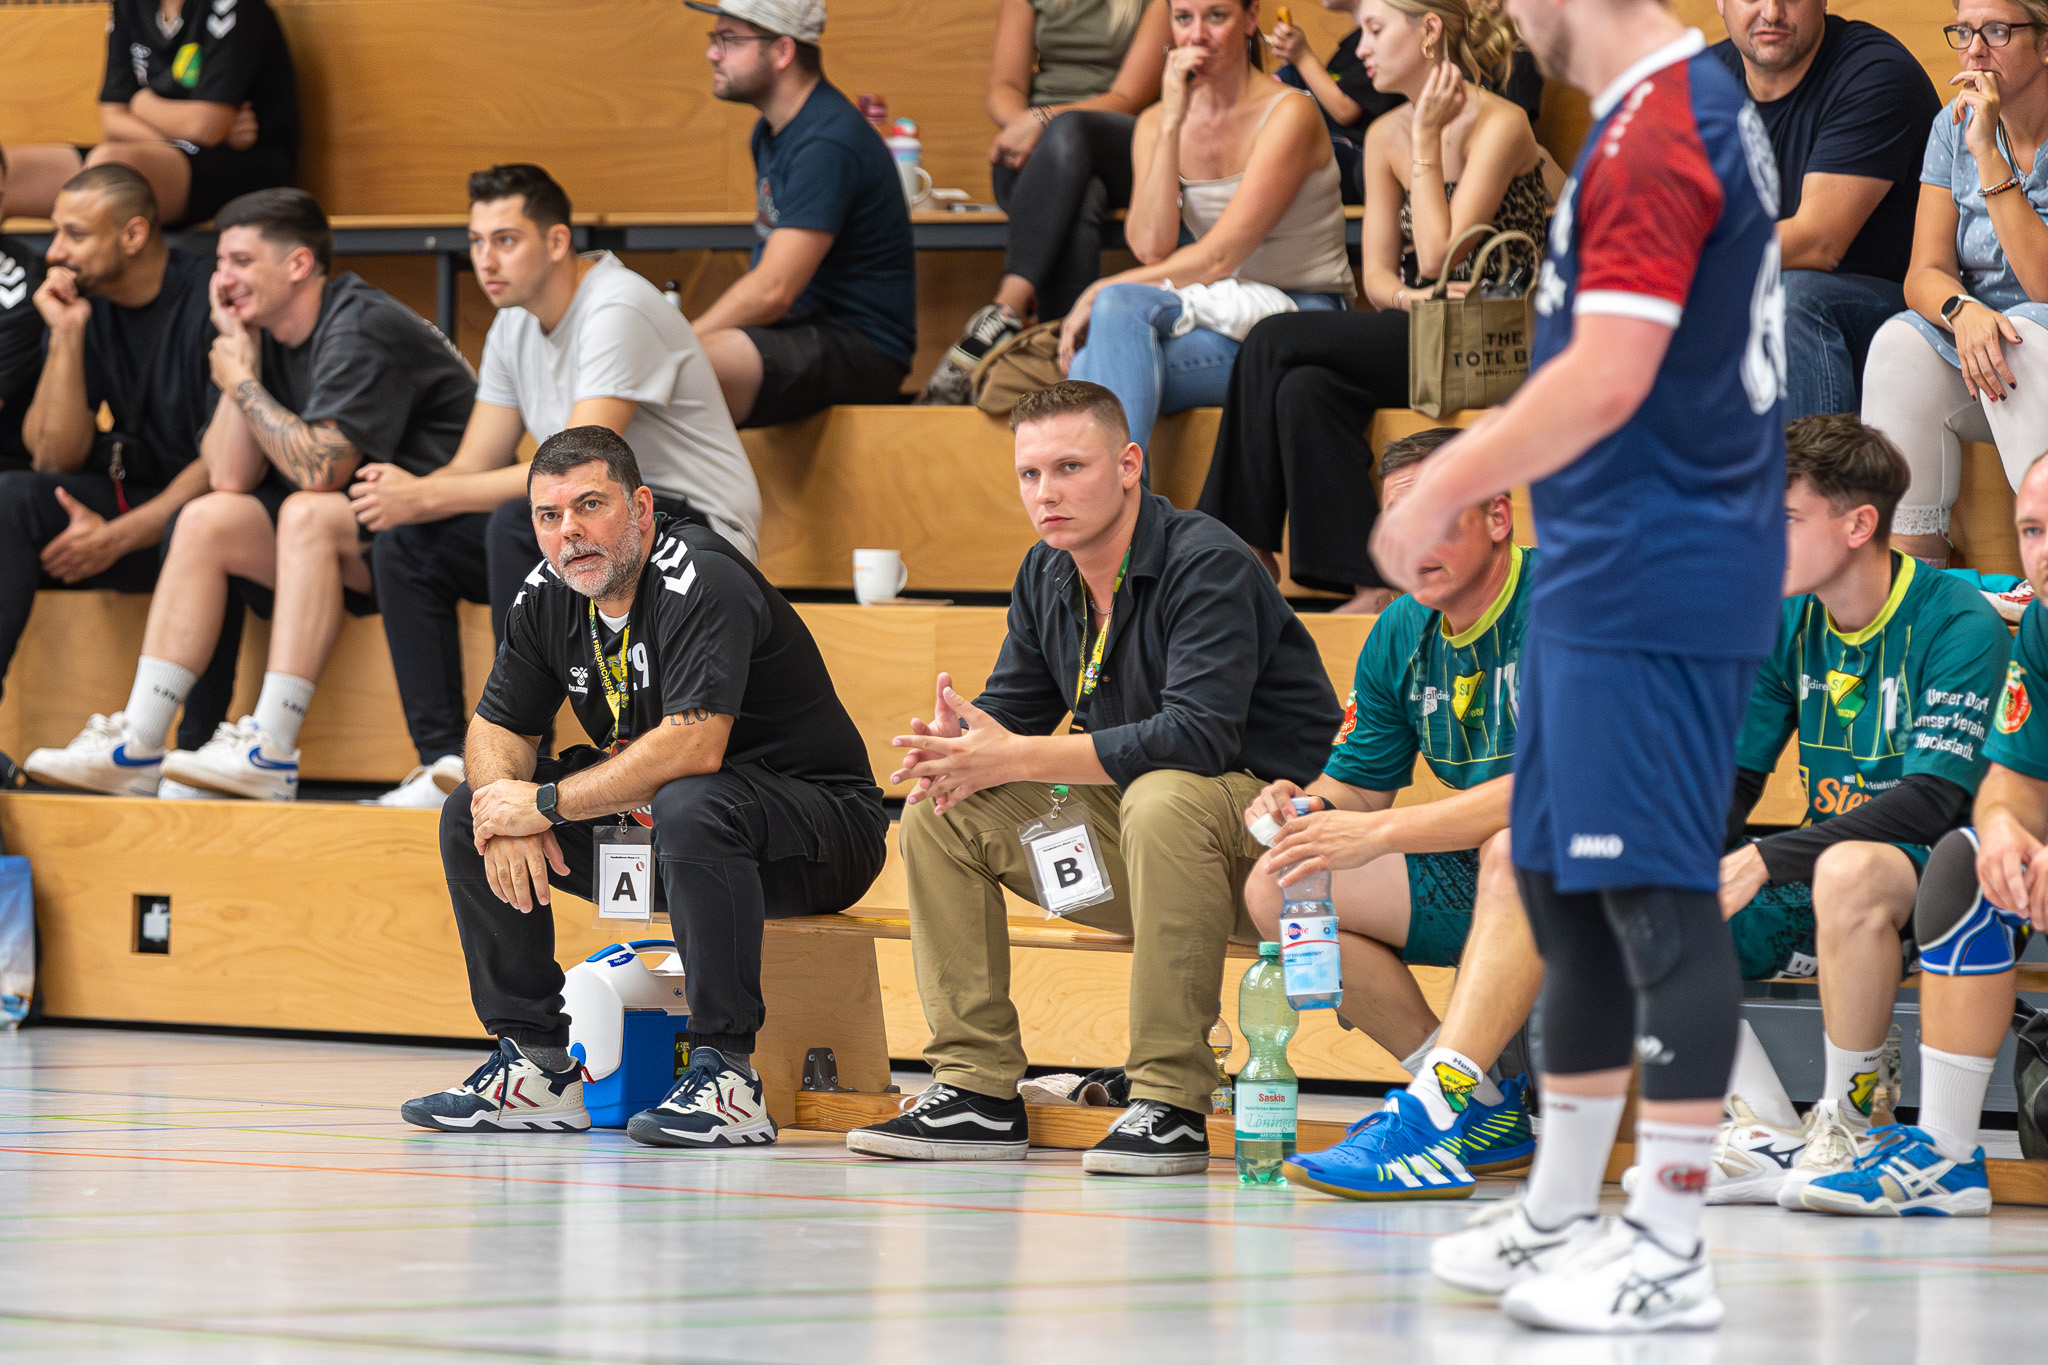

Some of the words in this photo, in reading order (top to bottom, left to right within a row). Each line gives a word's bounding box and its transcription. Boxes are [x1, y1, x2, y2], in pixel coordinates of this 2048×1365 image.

[1486, 331, 1523, 346] THE
[593, 639, 616, 698] FRIEDRICHSFE
[1926, 688, 1963, 707] Unser
[1568, 833, 1625, 859] JAKO
[1053, 857, 1083, 889] B
[612, 872, 637, 901] A
[1258, 1093, 1286, 1103] Saskia
